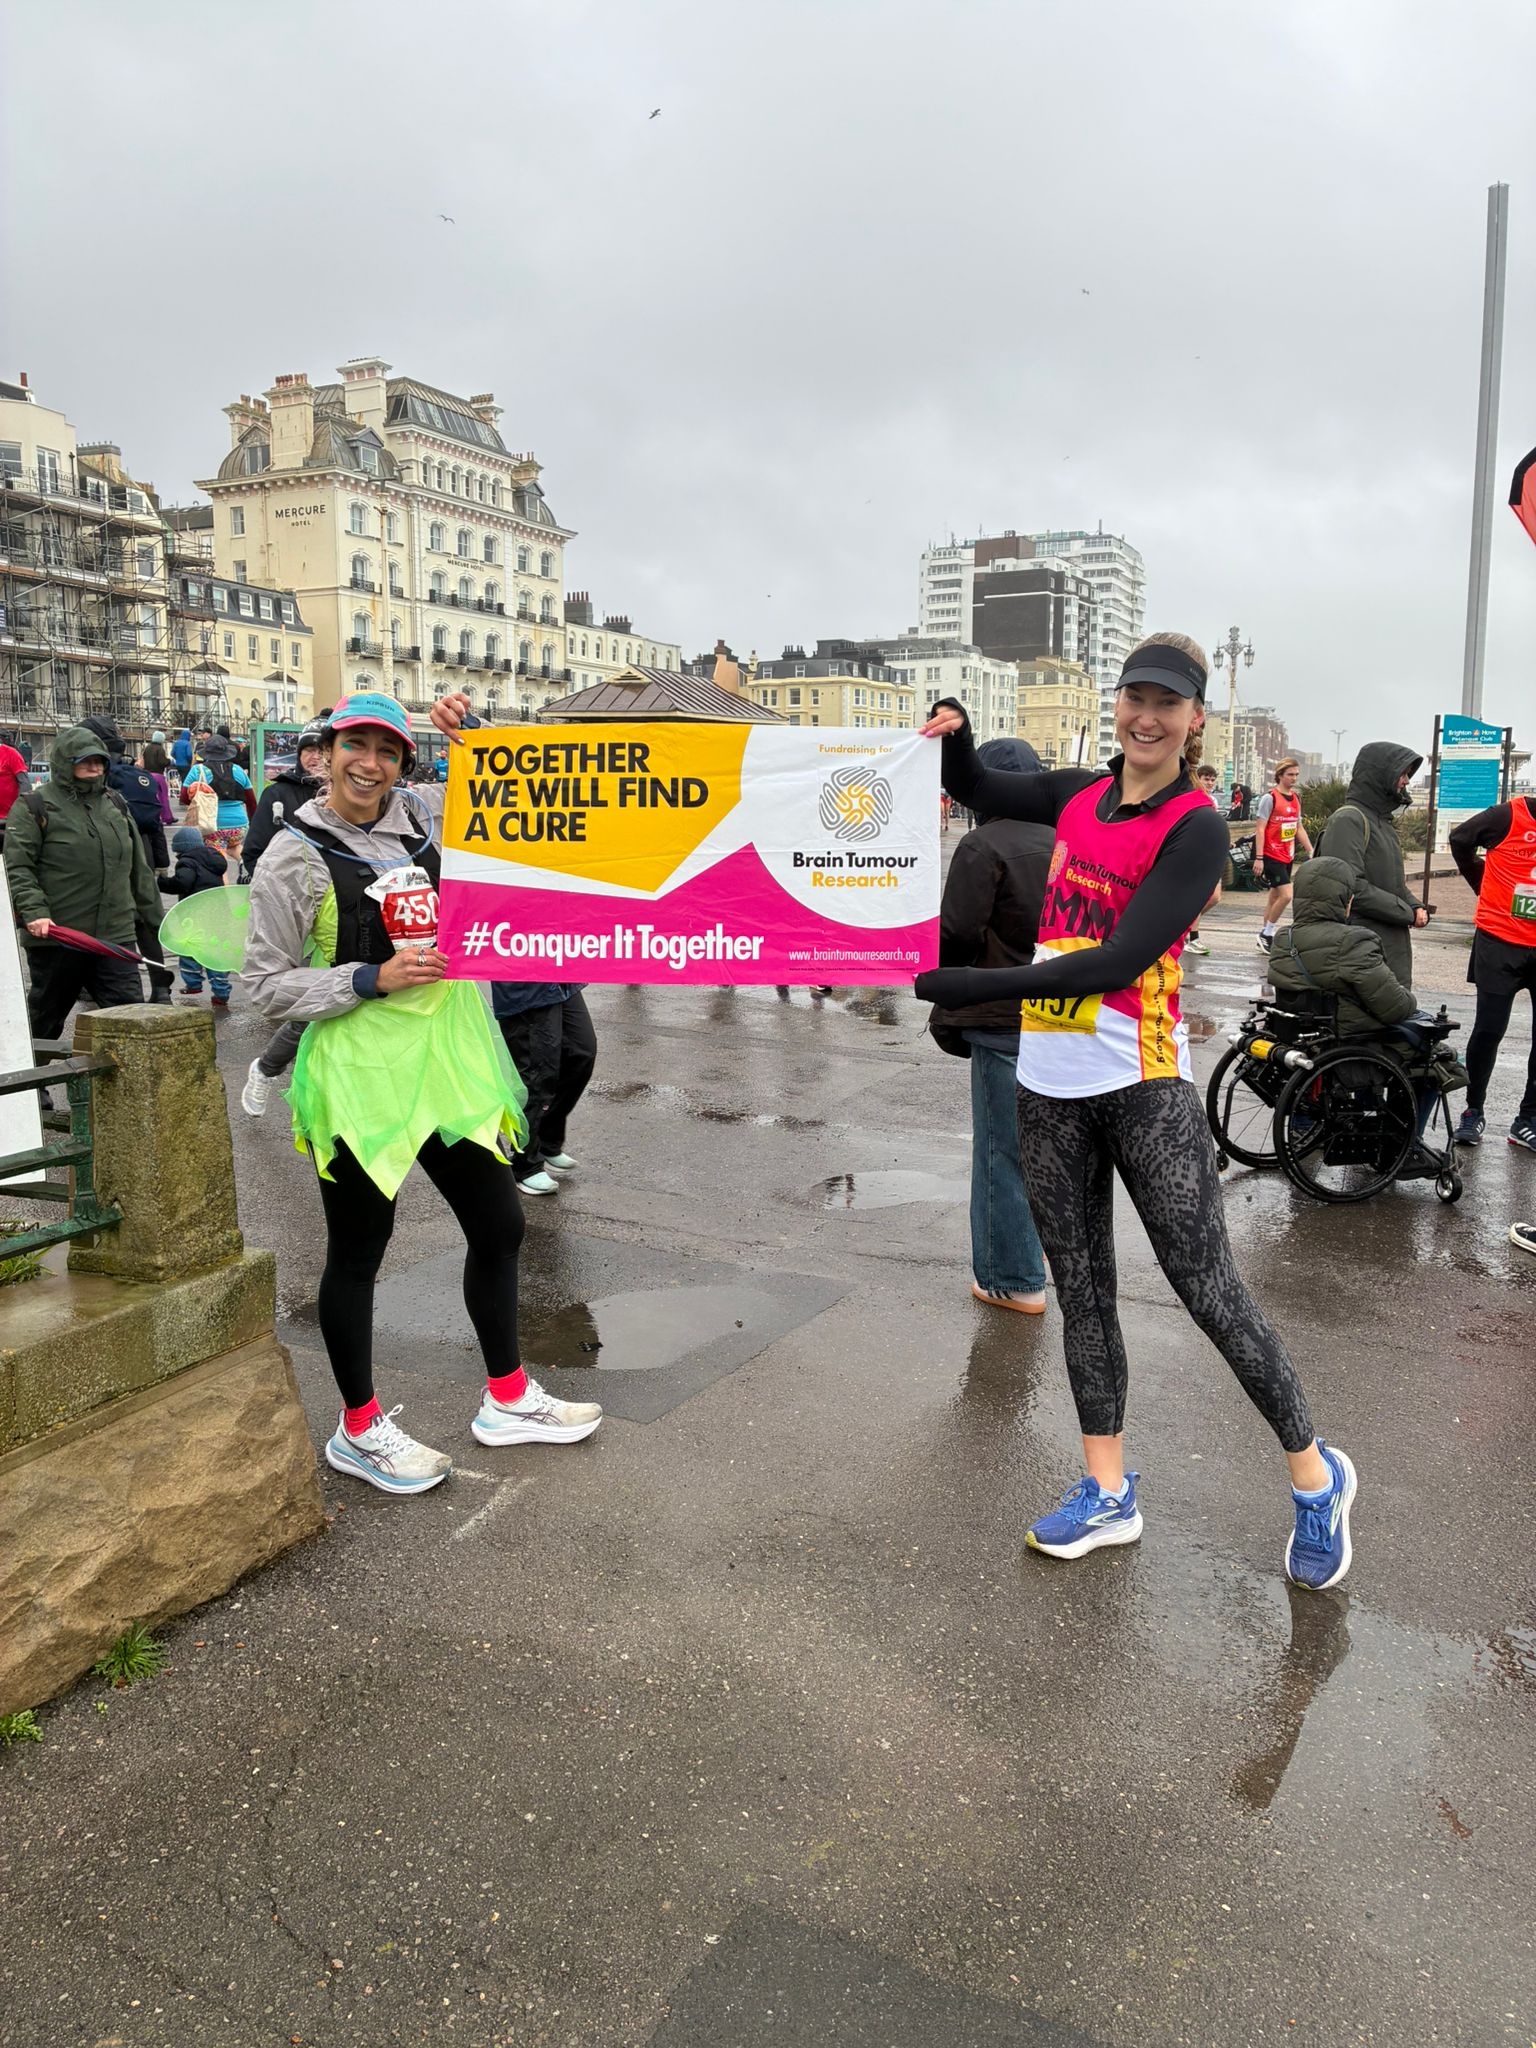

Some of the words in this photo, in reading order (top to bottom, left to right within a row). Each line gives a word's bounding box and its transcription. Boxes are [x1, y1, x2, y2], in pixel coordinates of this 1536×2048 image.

[275, 504, 326, 519] MERCURE
[447, 559, 470, 569] MERCURE
[366, 700, 395, 712] KIPRUN
[1448, 729, 1472, 737] Brighton
[819, 744, 876, 756] Fundraising
[879, 745, 893, 753] for
[472, 743, 650, 776] TOGETHER
[468, 779, 518, 808] WE
[526, 777, 608, 808] WILL
[618, 777, 709, 808] FIND
[464, 812, 490, 841] A
[499, 811, 586, 842] CURE
[793, 851, 843, 868] Brain
[846, 852, 918, 868] Tumour
[812, 870, 898, 887] Research
[1069, 854, 1097, 874] Brain
[1097, 864, 1138, 890] Tumou
[1065, 867, 1112, 897] Research
[788, 947, 920, 964] www.braintumourresearch.org
[1029, 994, 1088, 1020] 57
